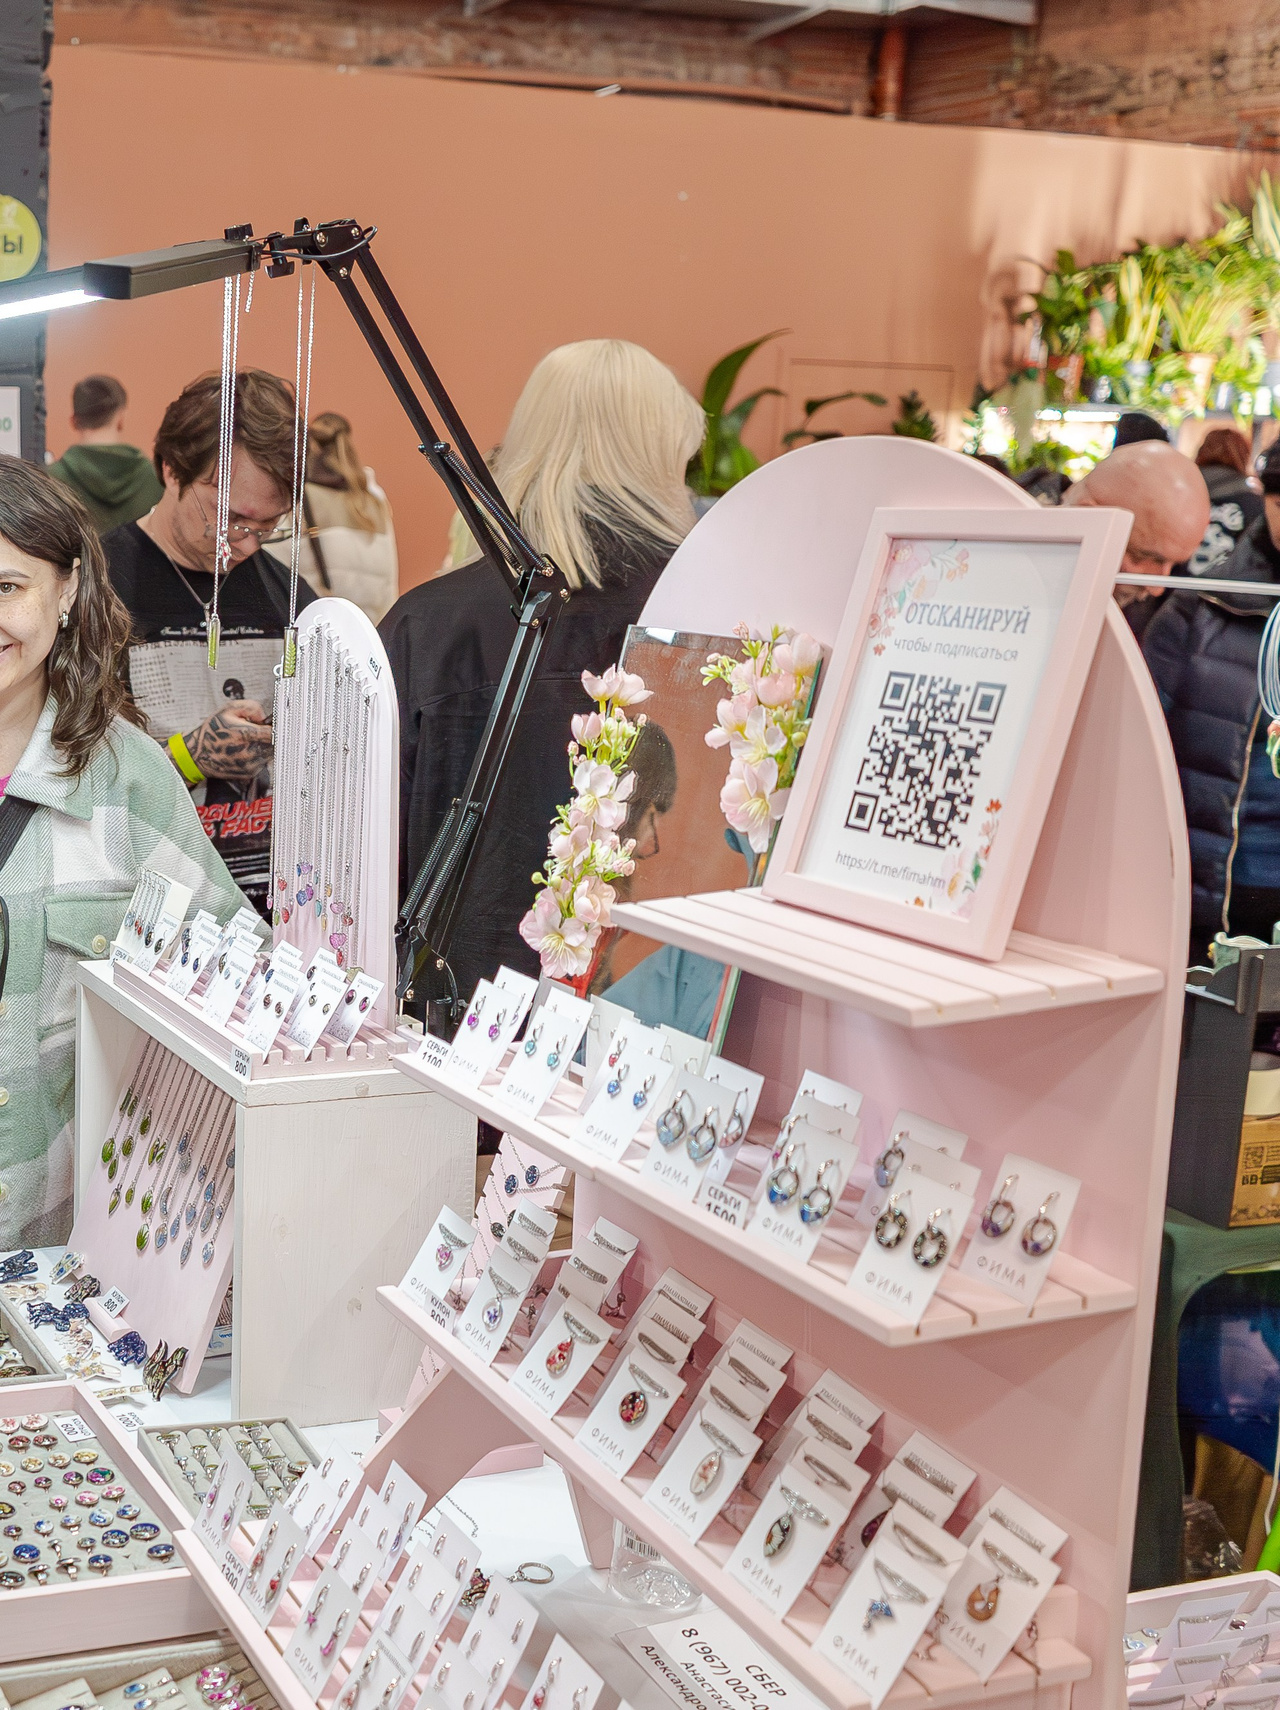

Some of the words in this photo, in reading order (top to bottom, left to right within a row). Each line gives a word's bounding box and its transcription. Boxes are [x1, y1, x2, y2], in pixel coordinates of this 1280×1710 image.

[905, 602, 1031, 634] ОТСКАНИРУЙ
[894, 637, 932, 653] чтобы
[933, 642, 1019, 661] подписаться
[835, 850, 946, 889] https://t.me/fimahm
[426, 1039, 449, 1057] СЕРЬГИ
[234, 1060, 247, 1077] 800
[653, 1161, 690, 1188] ФИМА
[708, 1185, 743, 1211] СЕРЬГИ
[103, 1298, 118, 1312] 800
[430, 1295, 451, 1318] КУЛОН
[465, 1322, 492, 1351] ФИМА
[525, 1369, 556, 1400] ФИМА
[60, 1423, 78, 1436] 600
[116, 1414, 137, 1428] 1000
[592, 1427, 625, 1461] ФИМА
[662, 1486, 698, 1524] ФИМА
[225, 1550, 244, 1577] СЕРЬГИ
[681, 1628, 699, 1639] 8
[688, 1641, 732, 1676] (967)
[745, 1664, 787, 1698] СБЕР
